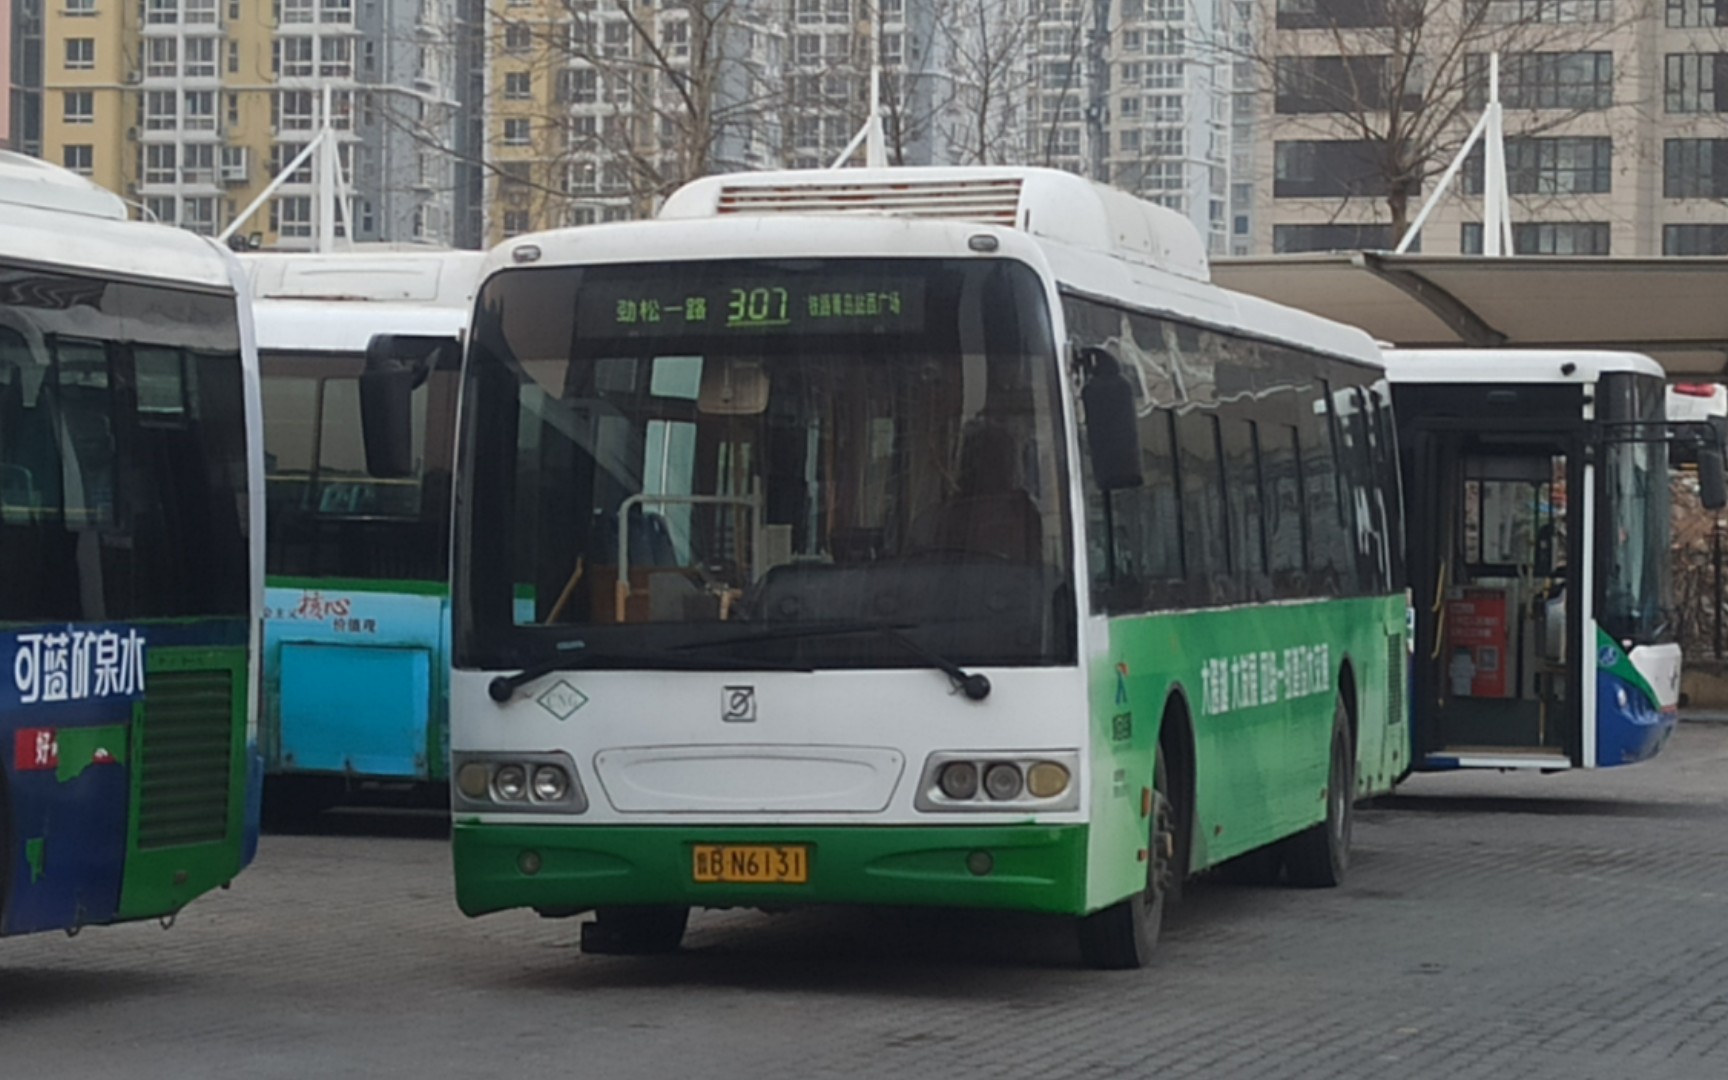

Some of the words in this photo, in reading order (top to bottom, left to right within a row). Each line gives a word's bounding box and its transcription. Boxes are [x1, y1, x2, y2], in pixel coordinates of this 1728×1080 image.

[616, 297, 708, 323] 劲松一路
[728, 287, 790, 321] 307
[297, 591, 350, 619] 核心
[15, 628, 146, 703] 可蓝矿泉水
